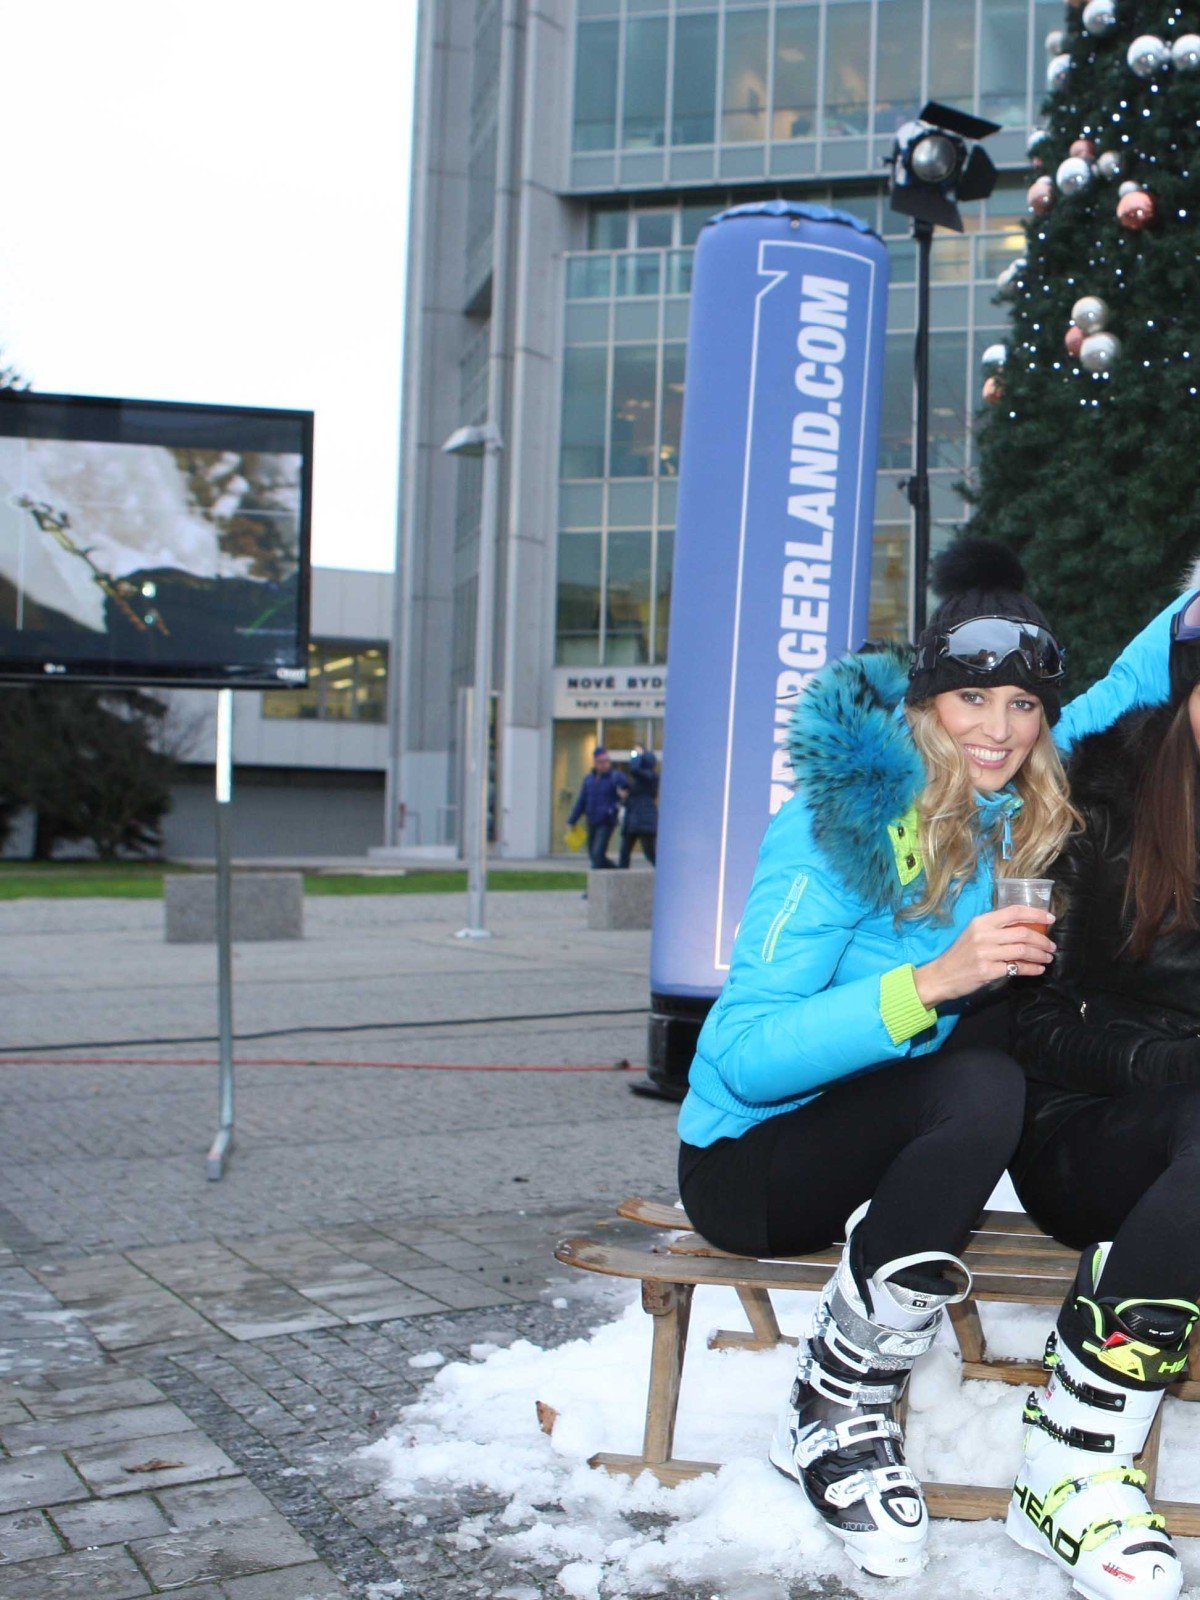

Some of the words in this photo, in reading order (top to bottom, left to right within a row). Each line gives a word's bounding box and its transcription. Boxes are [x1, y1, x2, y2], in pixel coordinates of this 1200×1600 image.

[567, 675, 615, 689] NOVÉ
[627, 676, 663, 689] BYD
[1013, 1474, 1081, 1567] HEAD
